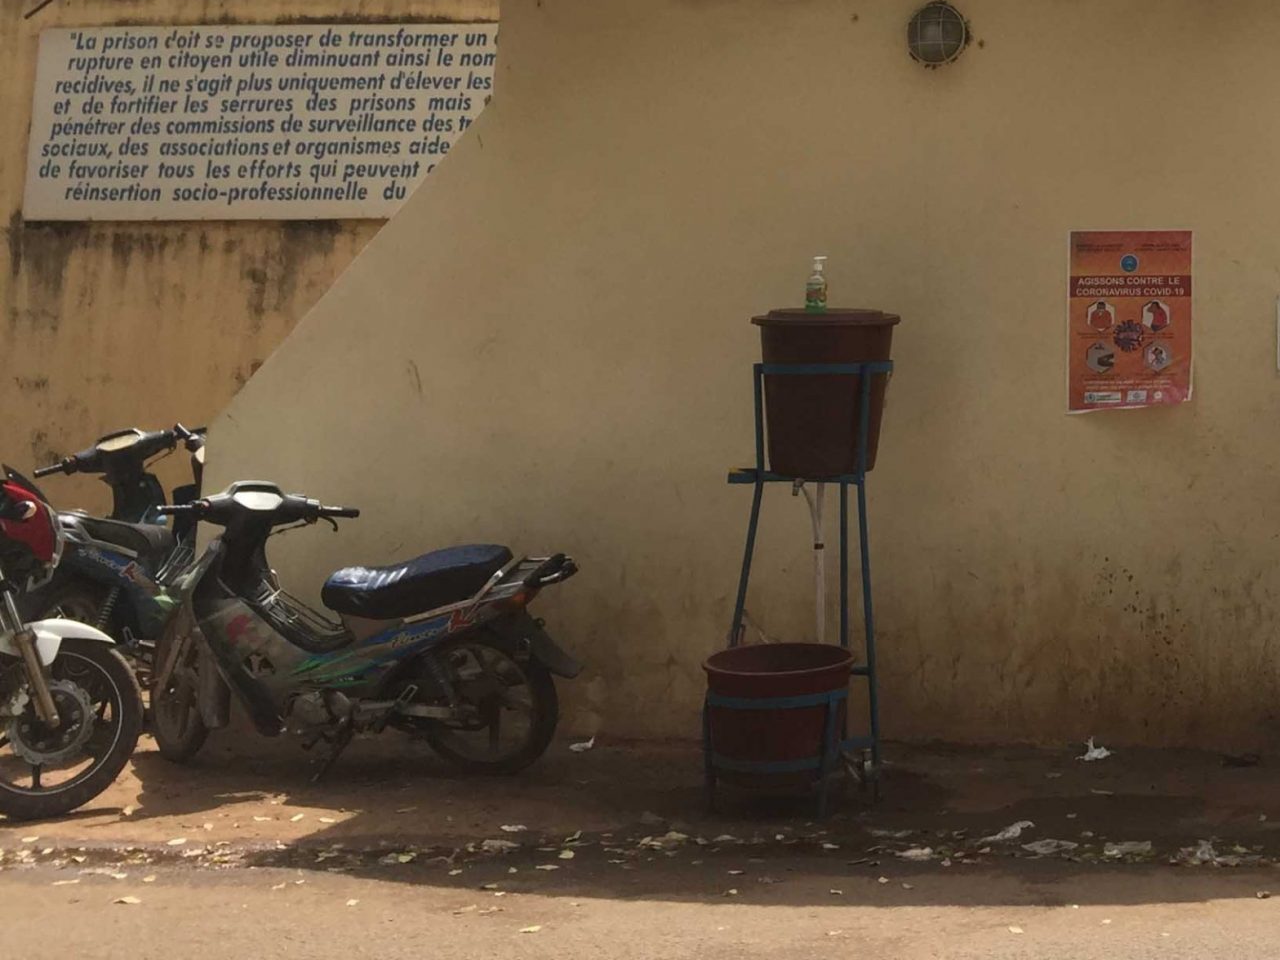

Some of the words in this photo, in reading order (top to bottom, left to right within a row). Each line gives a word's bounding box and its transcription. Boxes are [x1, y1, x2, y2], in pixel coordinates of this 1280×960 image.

[102, 32, 158, 53] prison
[164, 31, 201, 48] doit
[205, 34, 224, 48] se
[230, 30, 313, 52] proposer
[318, 28, 342, 47] de
[348, 28, 459, 47] transformer
[465, 33, 487, 46] un
[67, 53, 134, 74] rupture
[140, 55, 162, 69] en
[168, 51, 232, 72] citoyen
[239, 49, 279, 67] utile
[285, 49, 380, 66] diminuant
[386, 48, 430, 66] ainsi
[436, 48, 453, 66] le
[55, 75, 137, 96] recidives,
[142, 75, 155, 91] il
[159, 79, 180, 92] ne
[184, 74, 233, 97] s'agit
[236, 73, 272, 96] plus
[278, 73, 385, 94] uniquement
[390, 71, 461, 89] d'élever
[466, 71, 492, 89] les
[53, 99, 71, 115] et
[82, 97, 104, 114] de
[110, 95, 178, 114] fortifier
[183, 95, 208, 113] les
[220, 98, 293, 112] serrures
[305, 93, 337, 111] des
[349, 93, 416, 116] prisons
[428, 93, 472, 111] mais
[50, 117, 125, 140] pénétrer
[130, 117, 160, 134] des
[166, 116, 275, 134] commissions
[280, 114, 303, 132] de
[308, 114, 416, 132] surveillance
[422, 114, 452, 132] des
[41, 139, 113, 159] sociaux,
[119, 137, 148, 155] des
[159, 138, 269, 156] associations
[273, 140, 290, 155] et
[295, 137, 401, 159] organismes
[409, 136, 450, 154] aide
[39, 159, 61, 178] de
[68, 159, 149, 178] favoriser
[158, 162, 195, 178] tous
[206, 160, 230, 178] les
[237, 159, 301, 178] efforts
[309, 160, 338, 183] qui
[343, 162, 420, 182] peuvent
[64, 181, 161, 201] réinsertion
[172, 180, 368, 205] socio-professionnelle
[383, 180, 406, 200] du
[1076, 287, 1141, 296] CORONAVIRUS
[1143, 287, 1184, 296] COVID-19
[1078, 277, 1125, 286] AGISSONS
[1127, 276, 1163, 285] CONTRE
[1168, 276, 1180, 285] LE
